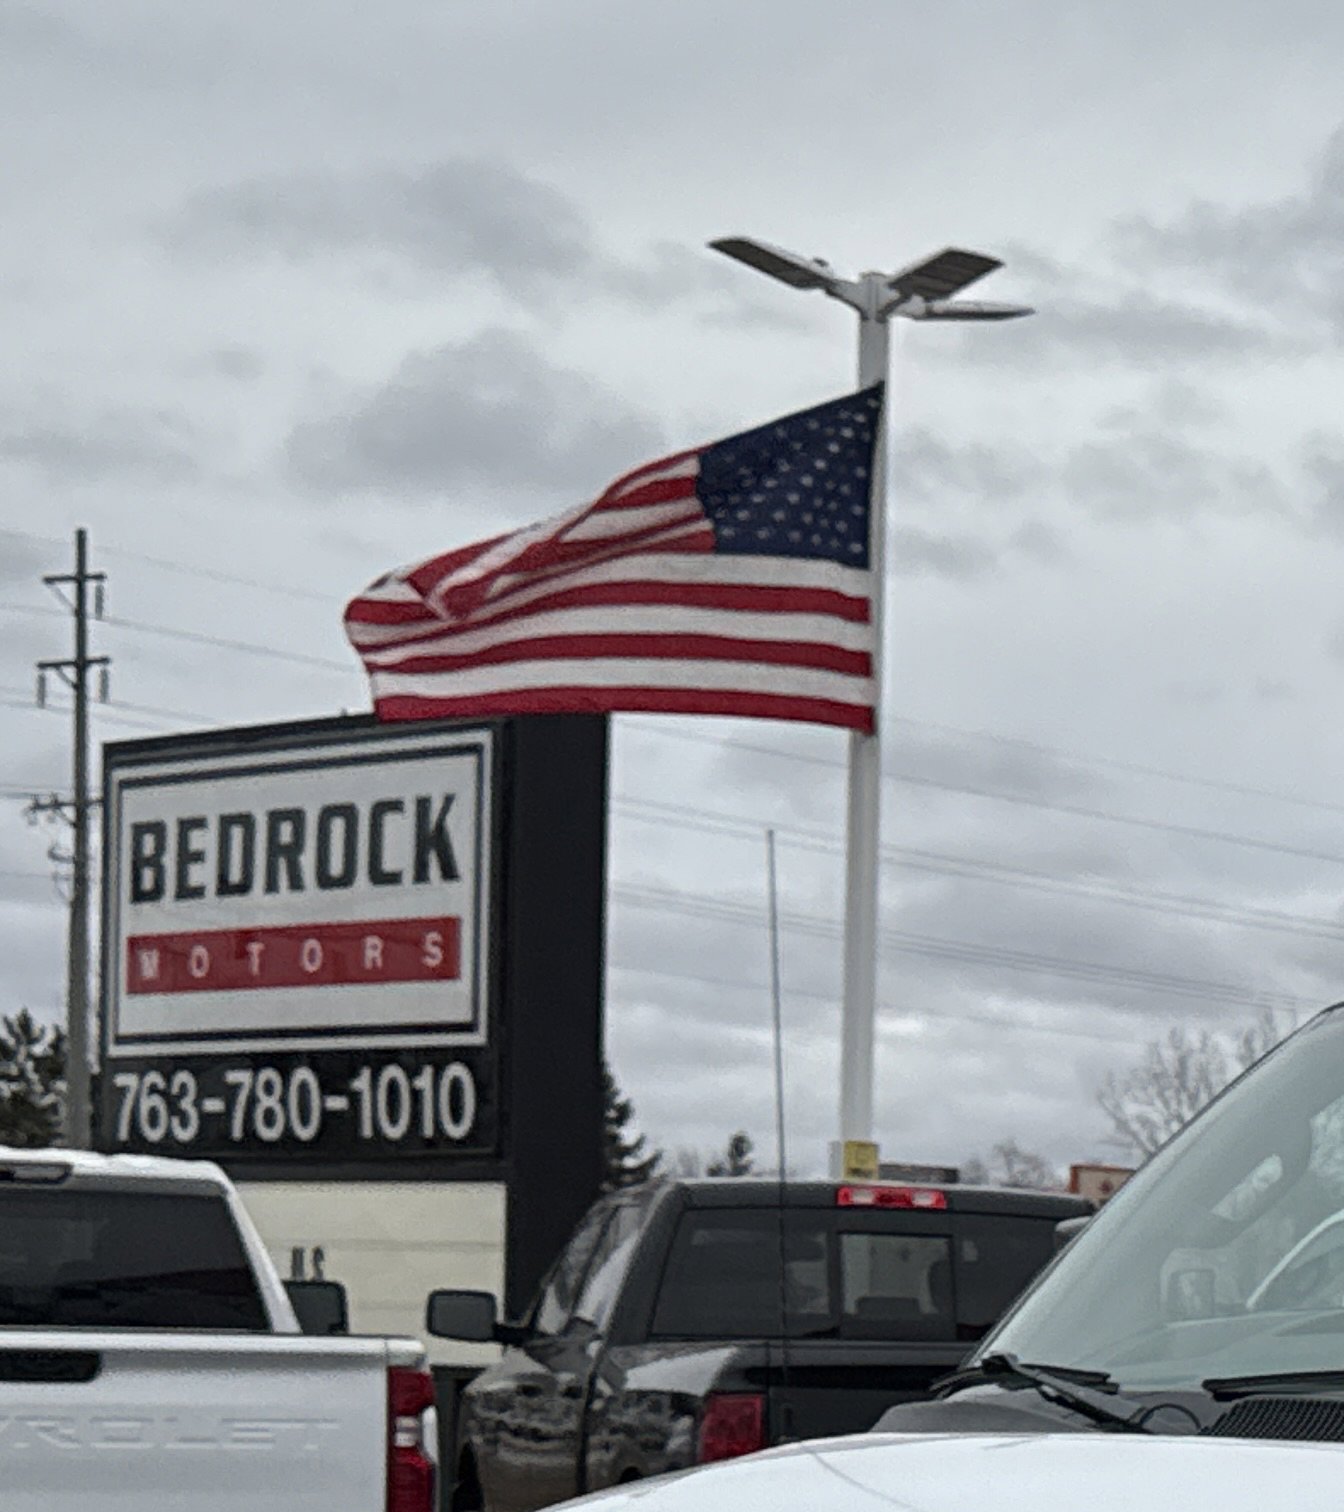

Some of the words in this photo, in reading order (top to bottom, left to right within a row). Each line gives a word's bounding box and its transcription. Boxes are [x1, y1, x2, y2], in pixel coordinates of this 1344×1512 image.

[130, 793, 460, 903] BEDROCK
[138, 932, 444, 981] MOTORS
[114, 1061, 476, 1143] 763-780-1010
